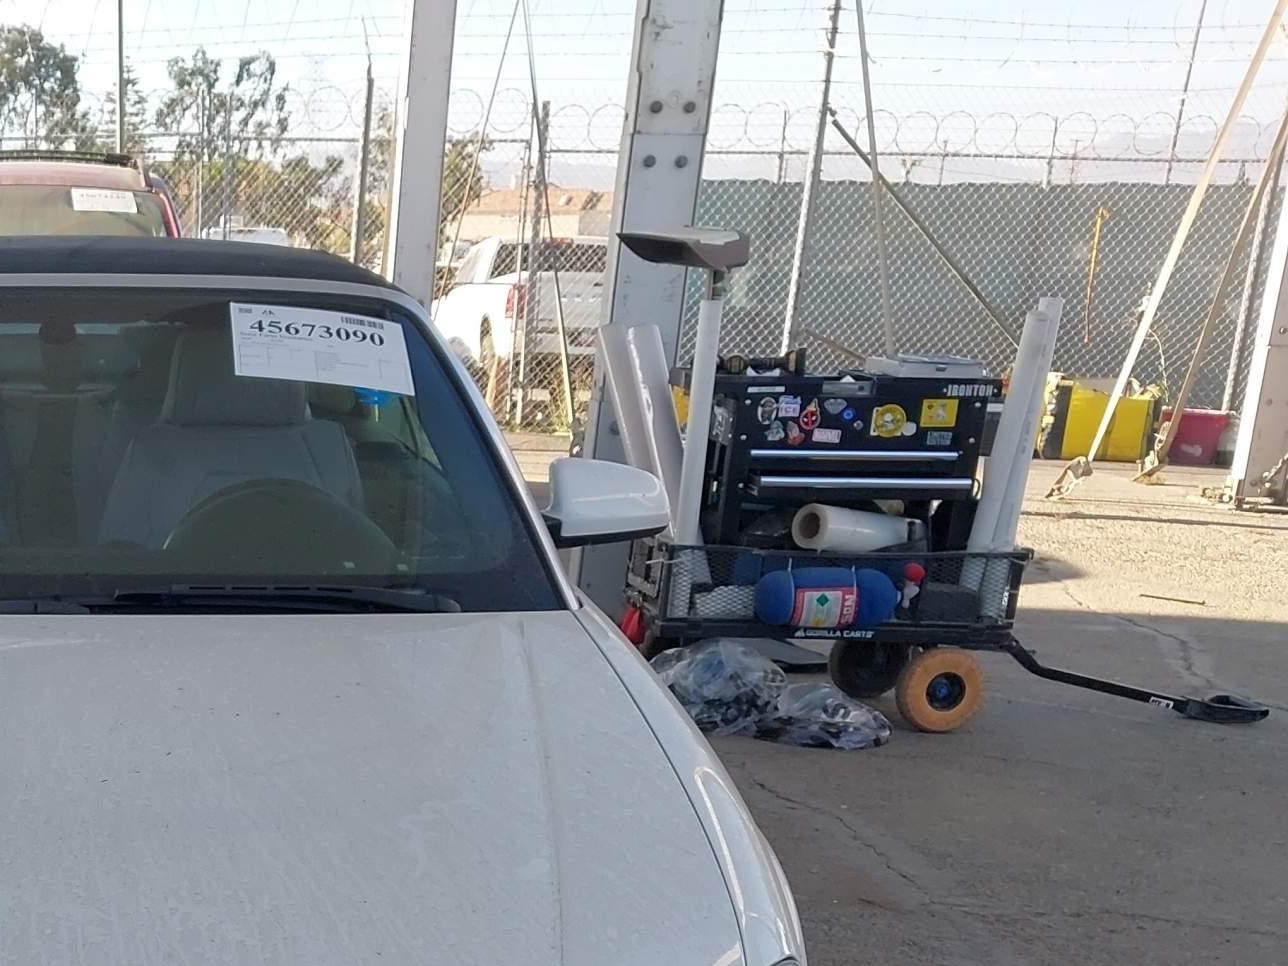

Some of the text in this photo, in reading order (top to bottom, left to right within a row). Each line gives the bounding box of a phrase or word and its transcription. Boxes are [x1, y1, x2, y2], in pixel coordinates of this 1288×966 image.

[249, 319, 385, 347] 45673090
[946, 383, 994, 397] IRONTON
[843, 630, 873, 639] CARTS
